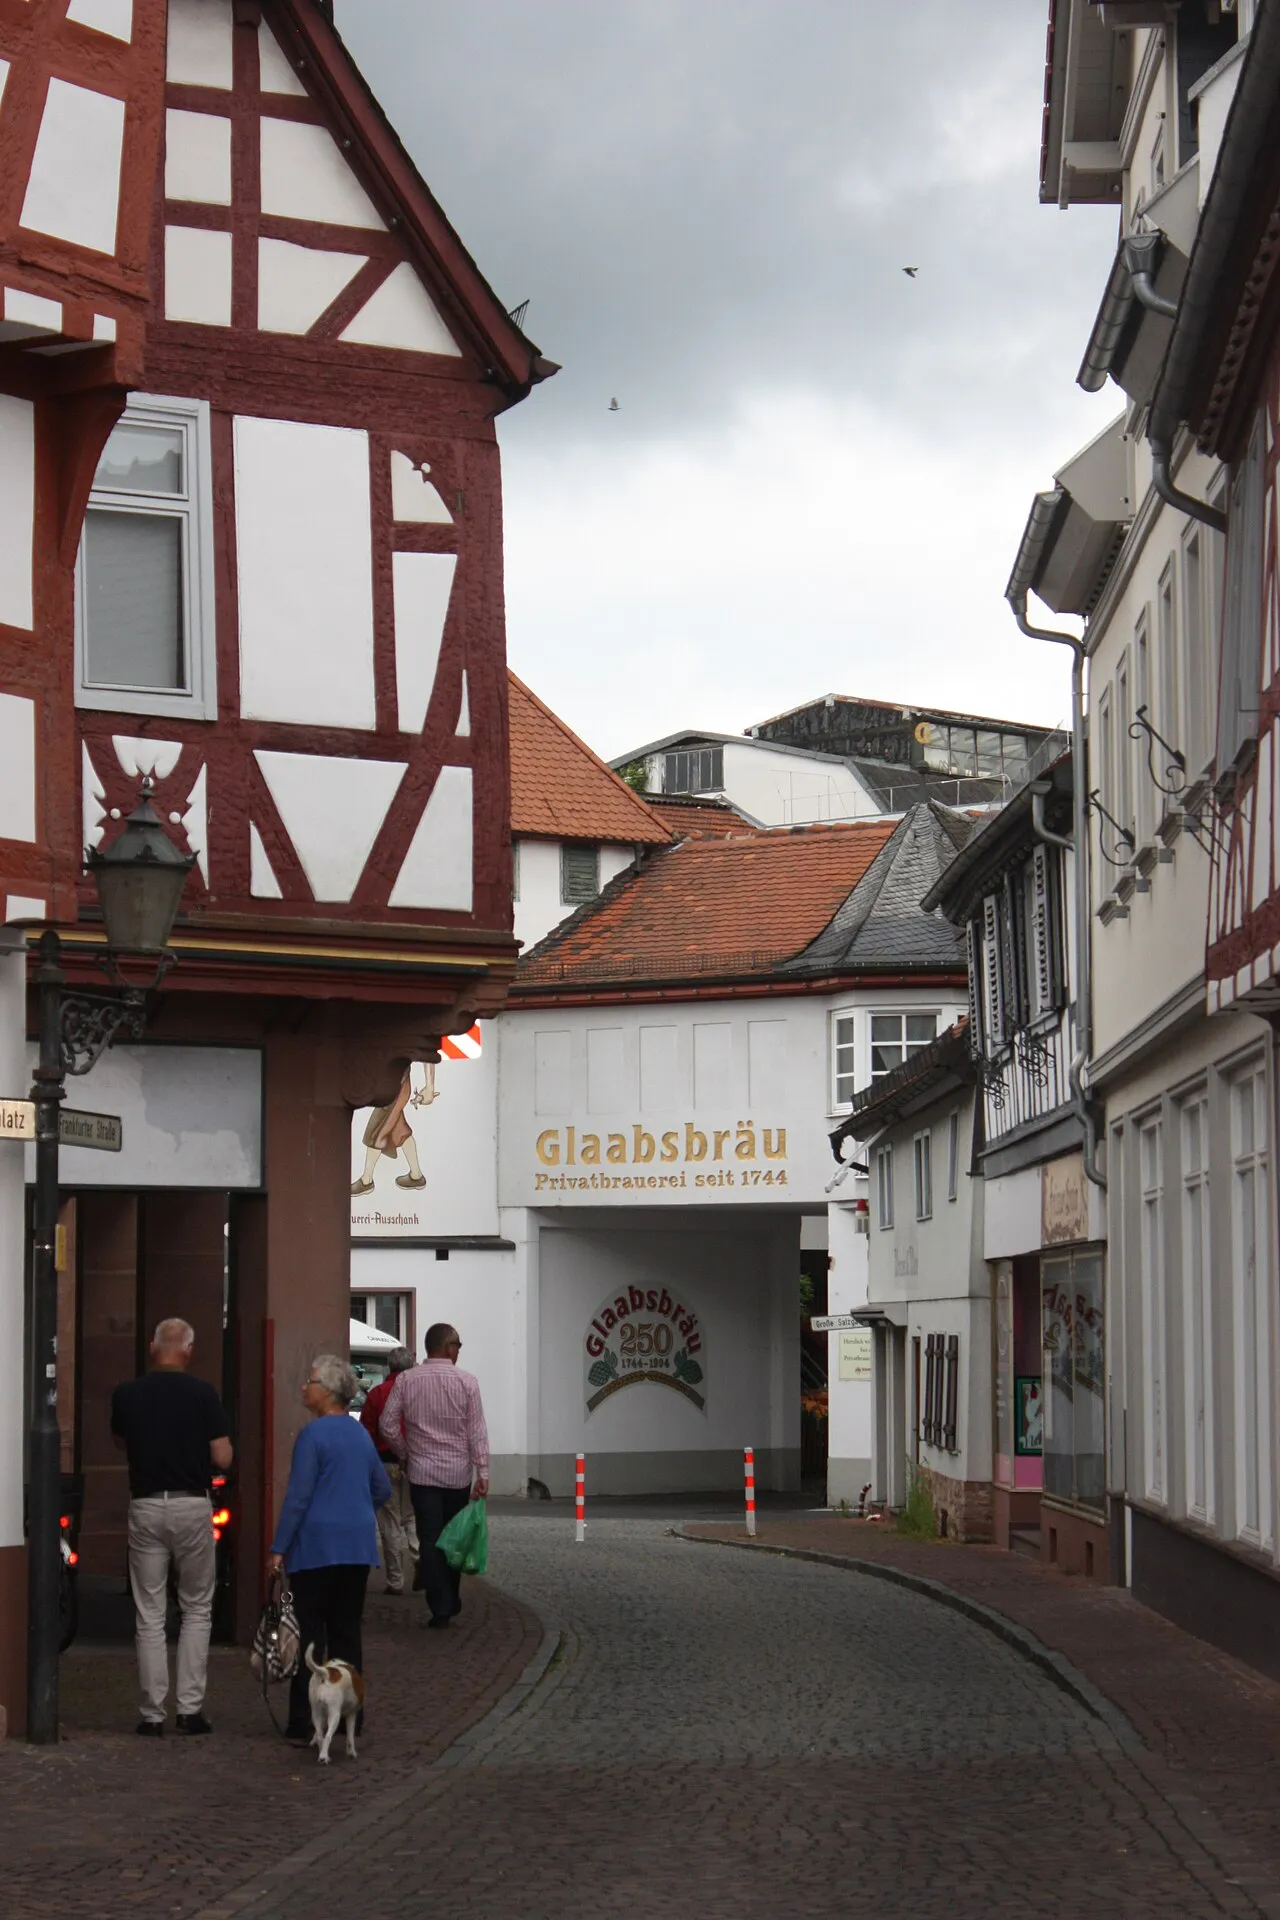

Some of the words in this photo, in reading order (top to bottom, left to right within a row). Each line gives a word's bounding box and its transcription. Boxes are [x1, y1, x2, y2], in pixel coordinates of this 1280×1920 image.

[0, 1108, 24, 1129] latz
[97, 1120, 115, 1141] Straße
[535, 1120, 788, 1166] Glaabsbräu
[535, 1171, 687, 1191] Privatbrauerei
[695, 1170, 735, 1187] seit
[741, 1169, 788, 1187] 1744
[586, 1285, 701, 1358] Glaabsbräu
[816, 1319, 834, 1328] Große
[619, 1323, 673, 1356] 250
